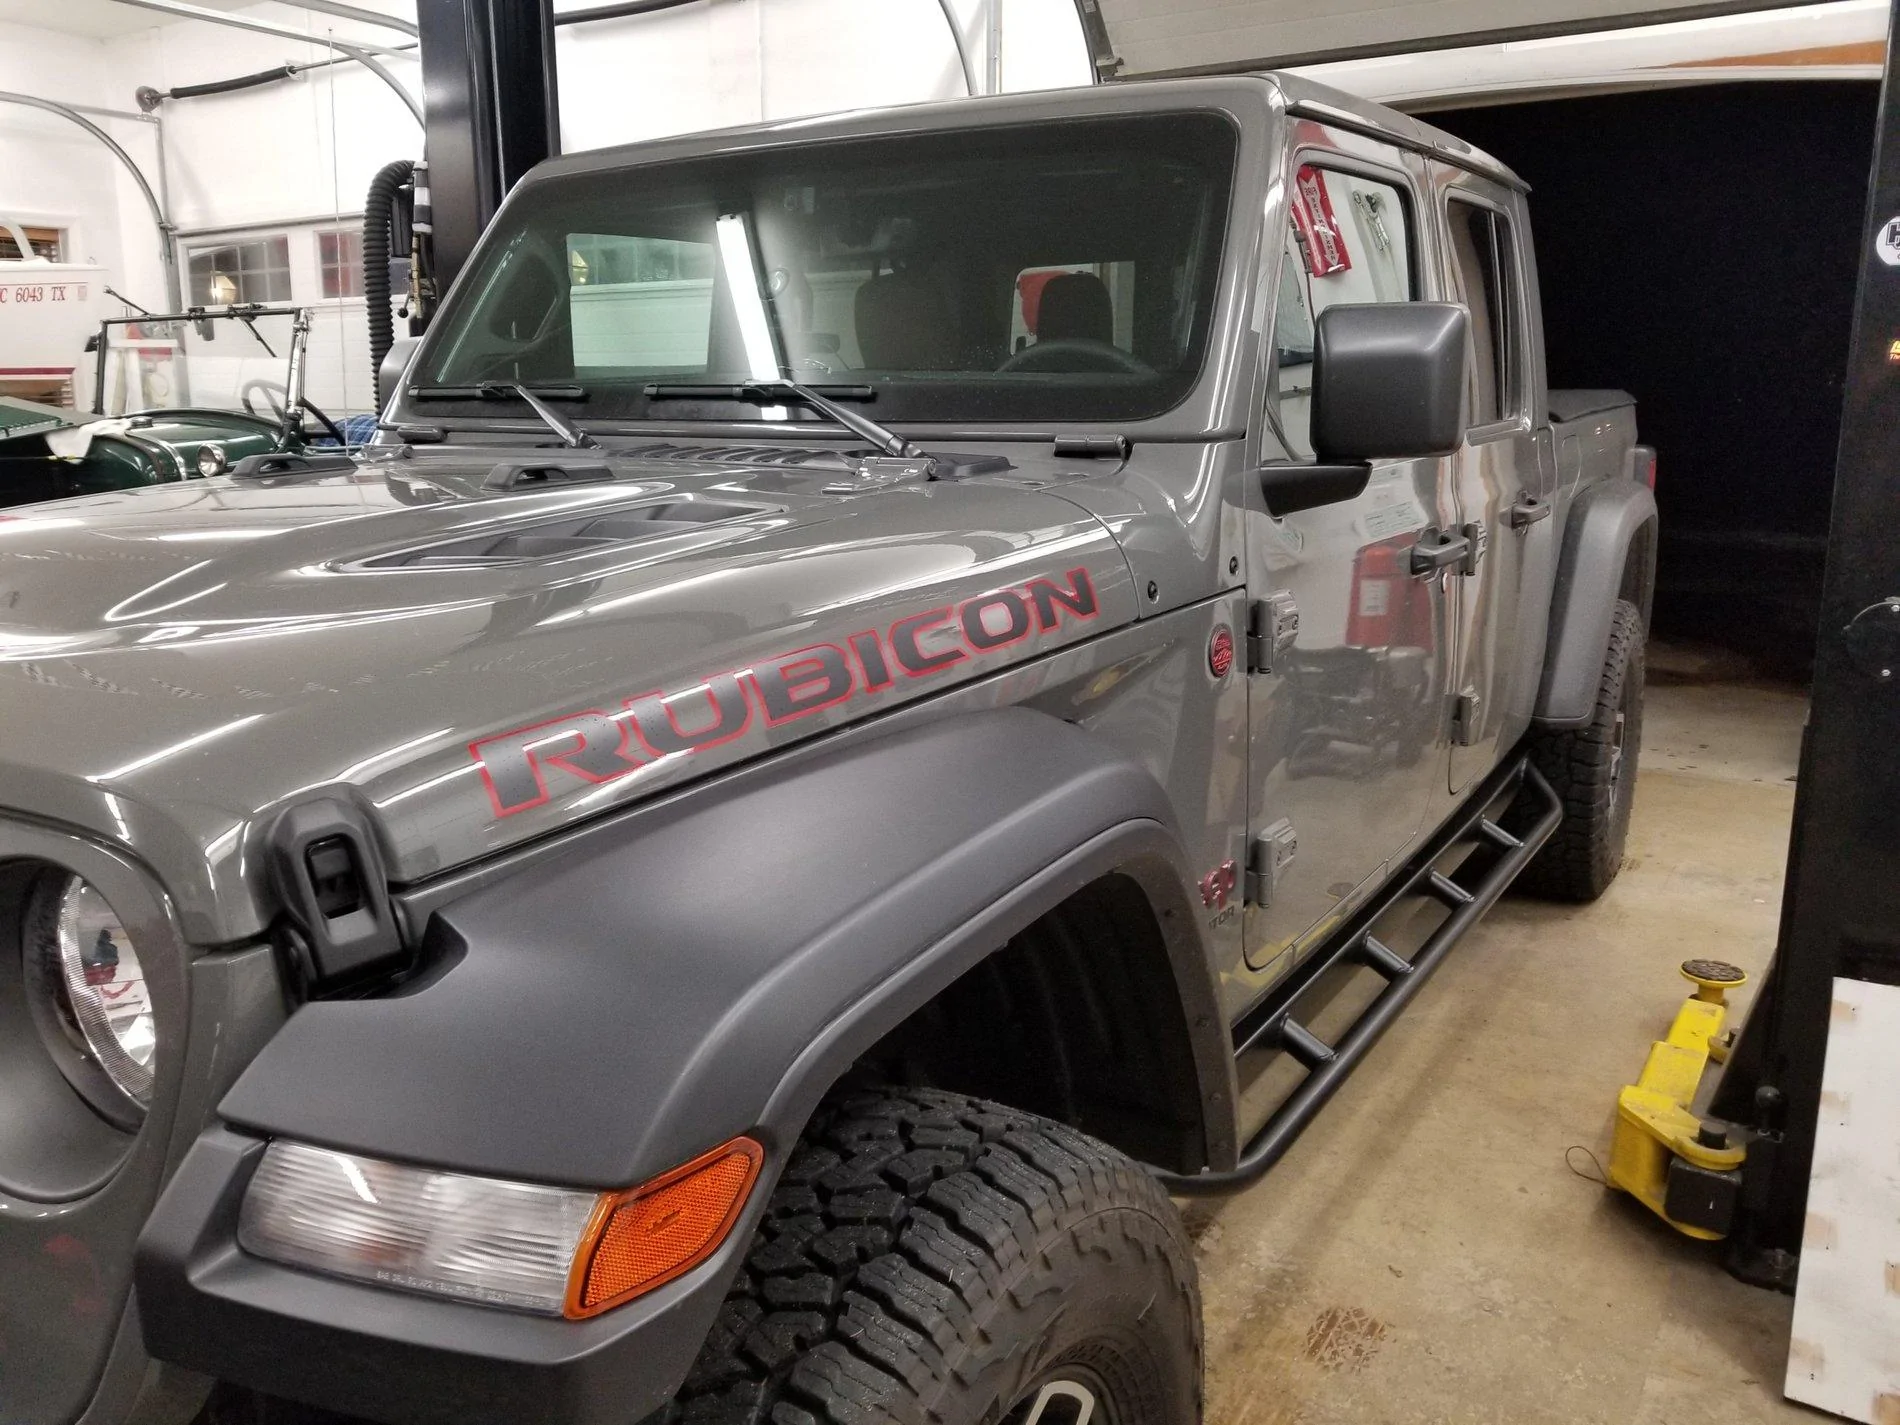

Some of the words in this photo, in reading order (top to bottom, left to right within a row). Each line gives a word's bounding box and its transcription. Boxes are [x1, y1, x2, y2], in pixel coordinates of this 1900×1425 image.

[15, 286, 44, 303] 6043
[51, 286, 67, 301] TX
[468, 567, 1101, 818] RUBICON
